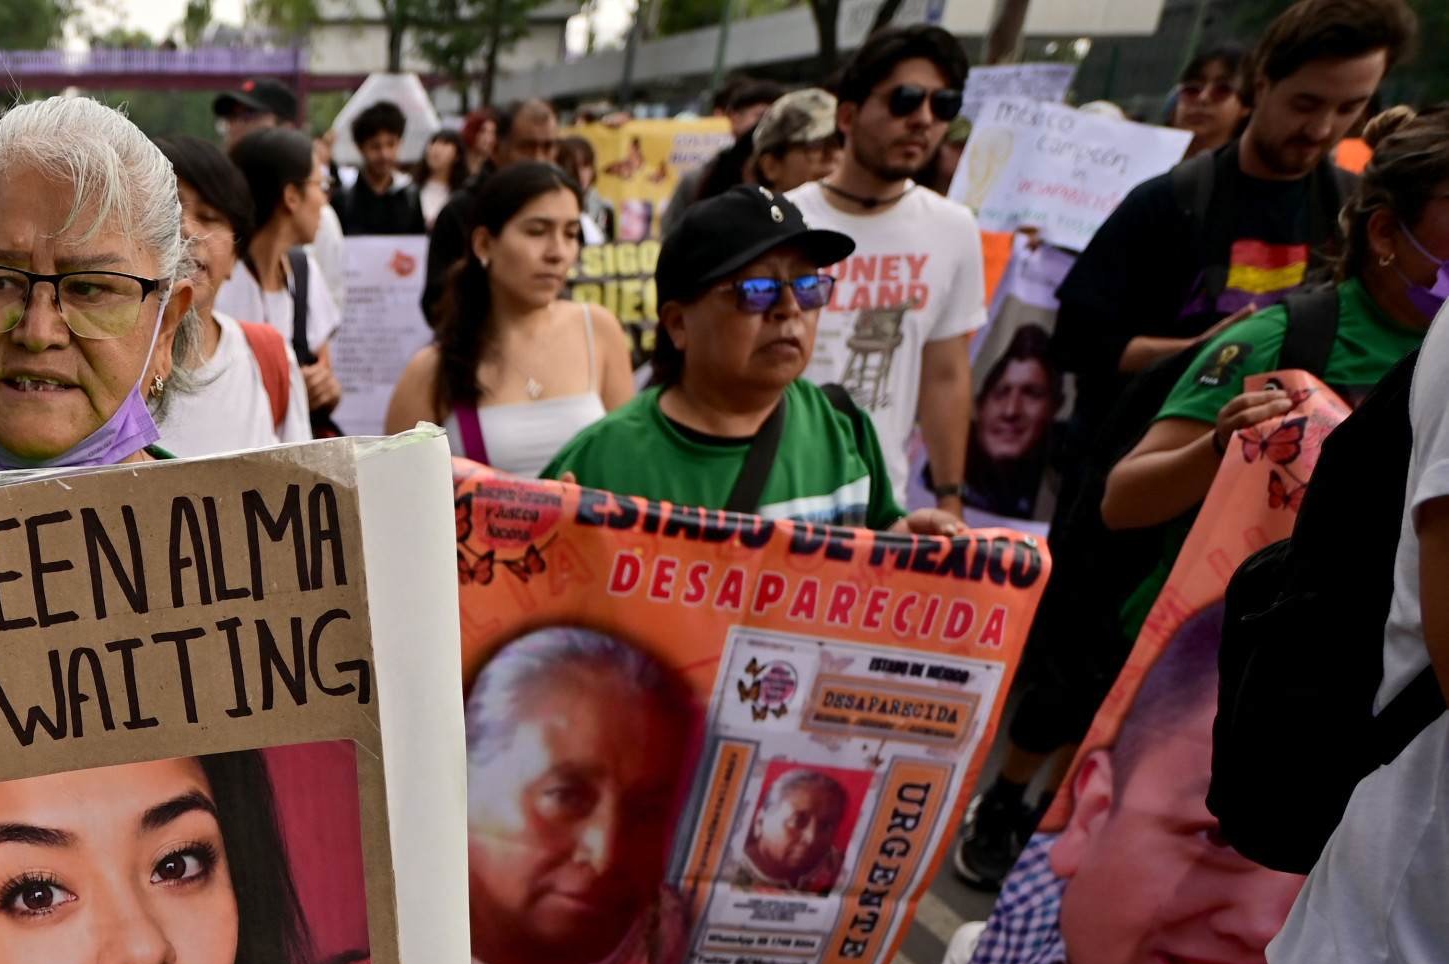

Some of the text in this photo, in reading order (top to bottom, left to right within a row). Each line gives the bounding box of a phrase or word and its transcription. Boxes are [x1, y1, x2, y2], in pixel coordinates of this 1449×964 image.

[168, 483, 347, 608] ALMA
[575, 486, 775, 548] ESTADO
[789, 520, 855, 561] DE
[608, 551, 1008, 648] DESAPARECIDA
[822, 690, 958, 724] DESAPARECIDA
[838, 782, 932, 960] URGENTE
